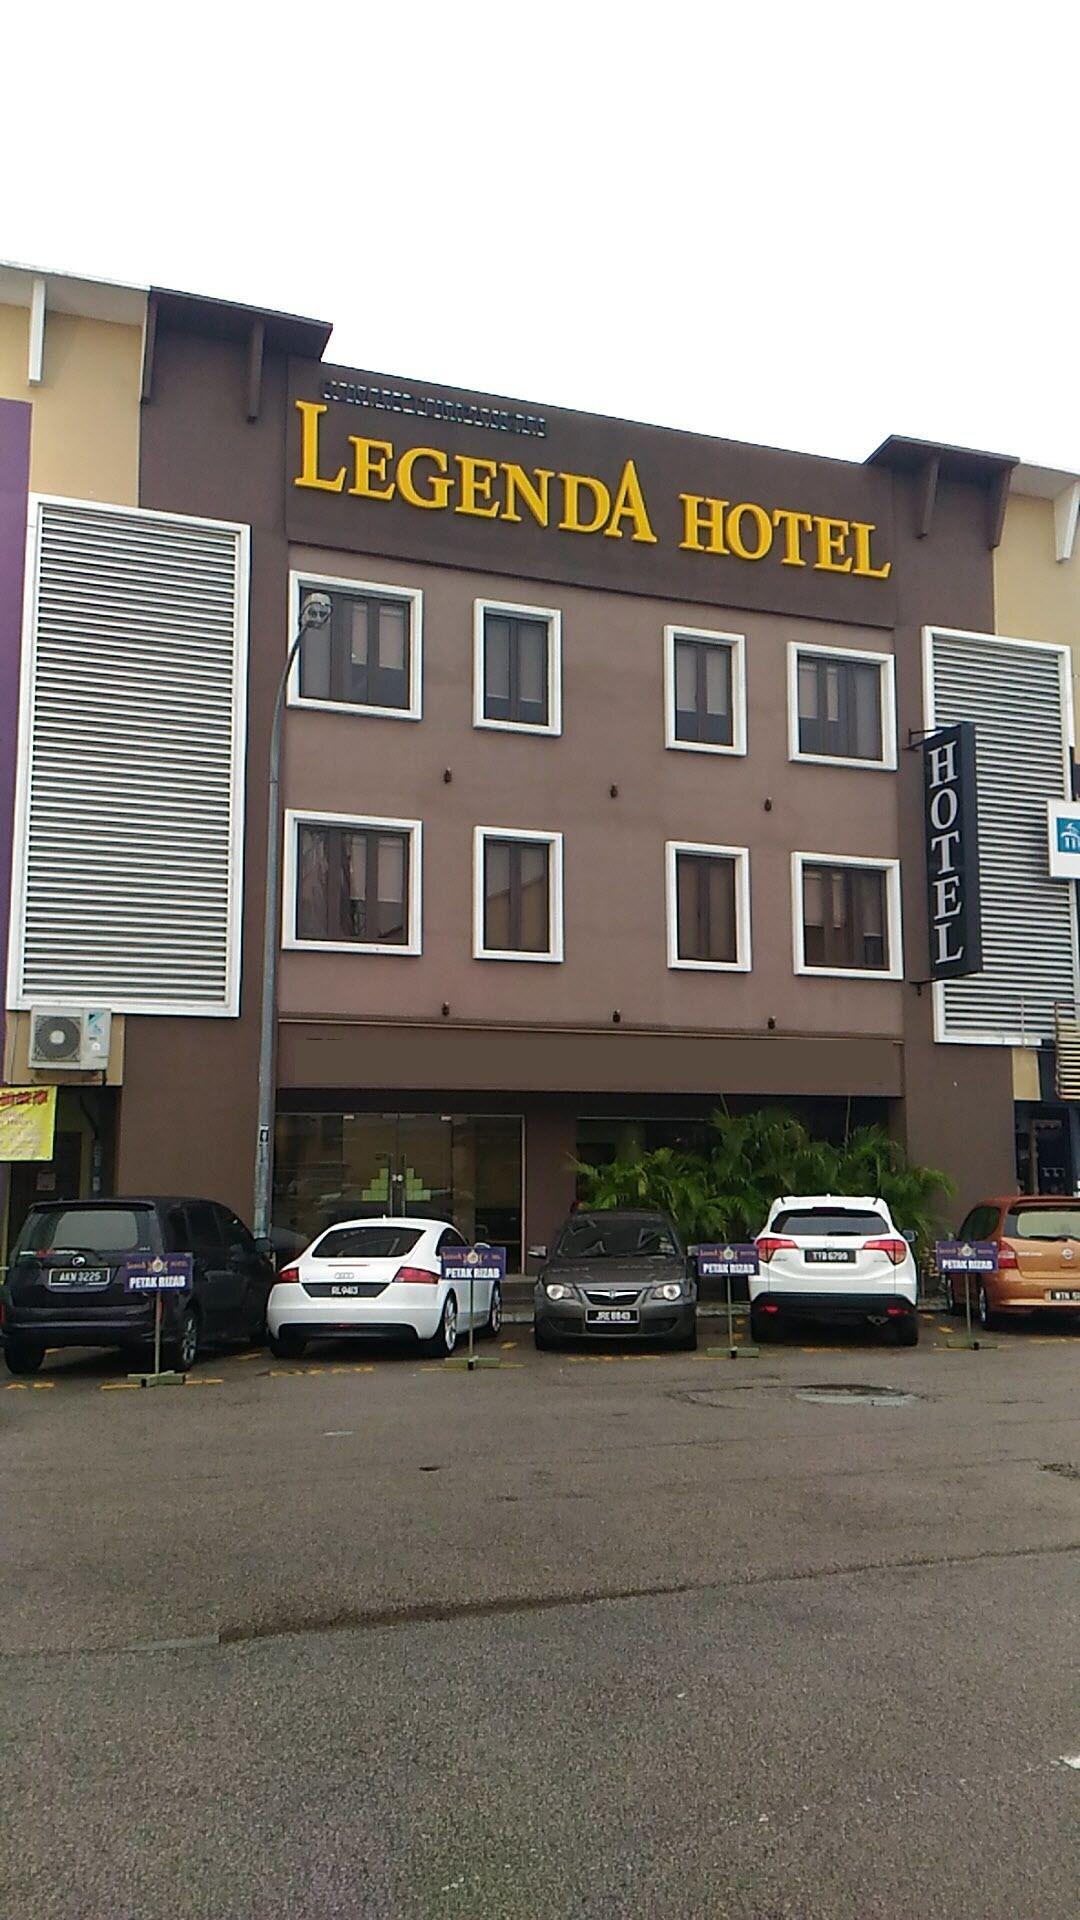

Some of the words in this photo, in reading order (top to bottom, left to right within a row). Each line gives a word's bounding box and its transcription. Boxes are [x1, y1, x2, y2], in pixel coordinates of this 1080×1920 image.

[294, 400, 658, 544] LEGENDA
[678, 492, 891, 579] HOTEL
[928, 741, 964, 964] HOTEL
[129, 1276, 158, 1289] PETAK
[158, 1275, 186, 1288] RIZAB
[445, 1267, 473, 1279] PETAK
